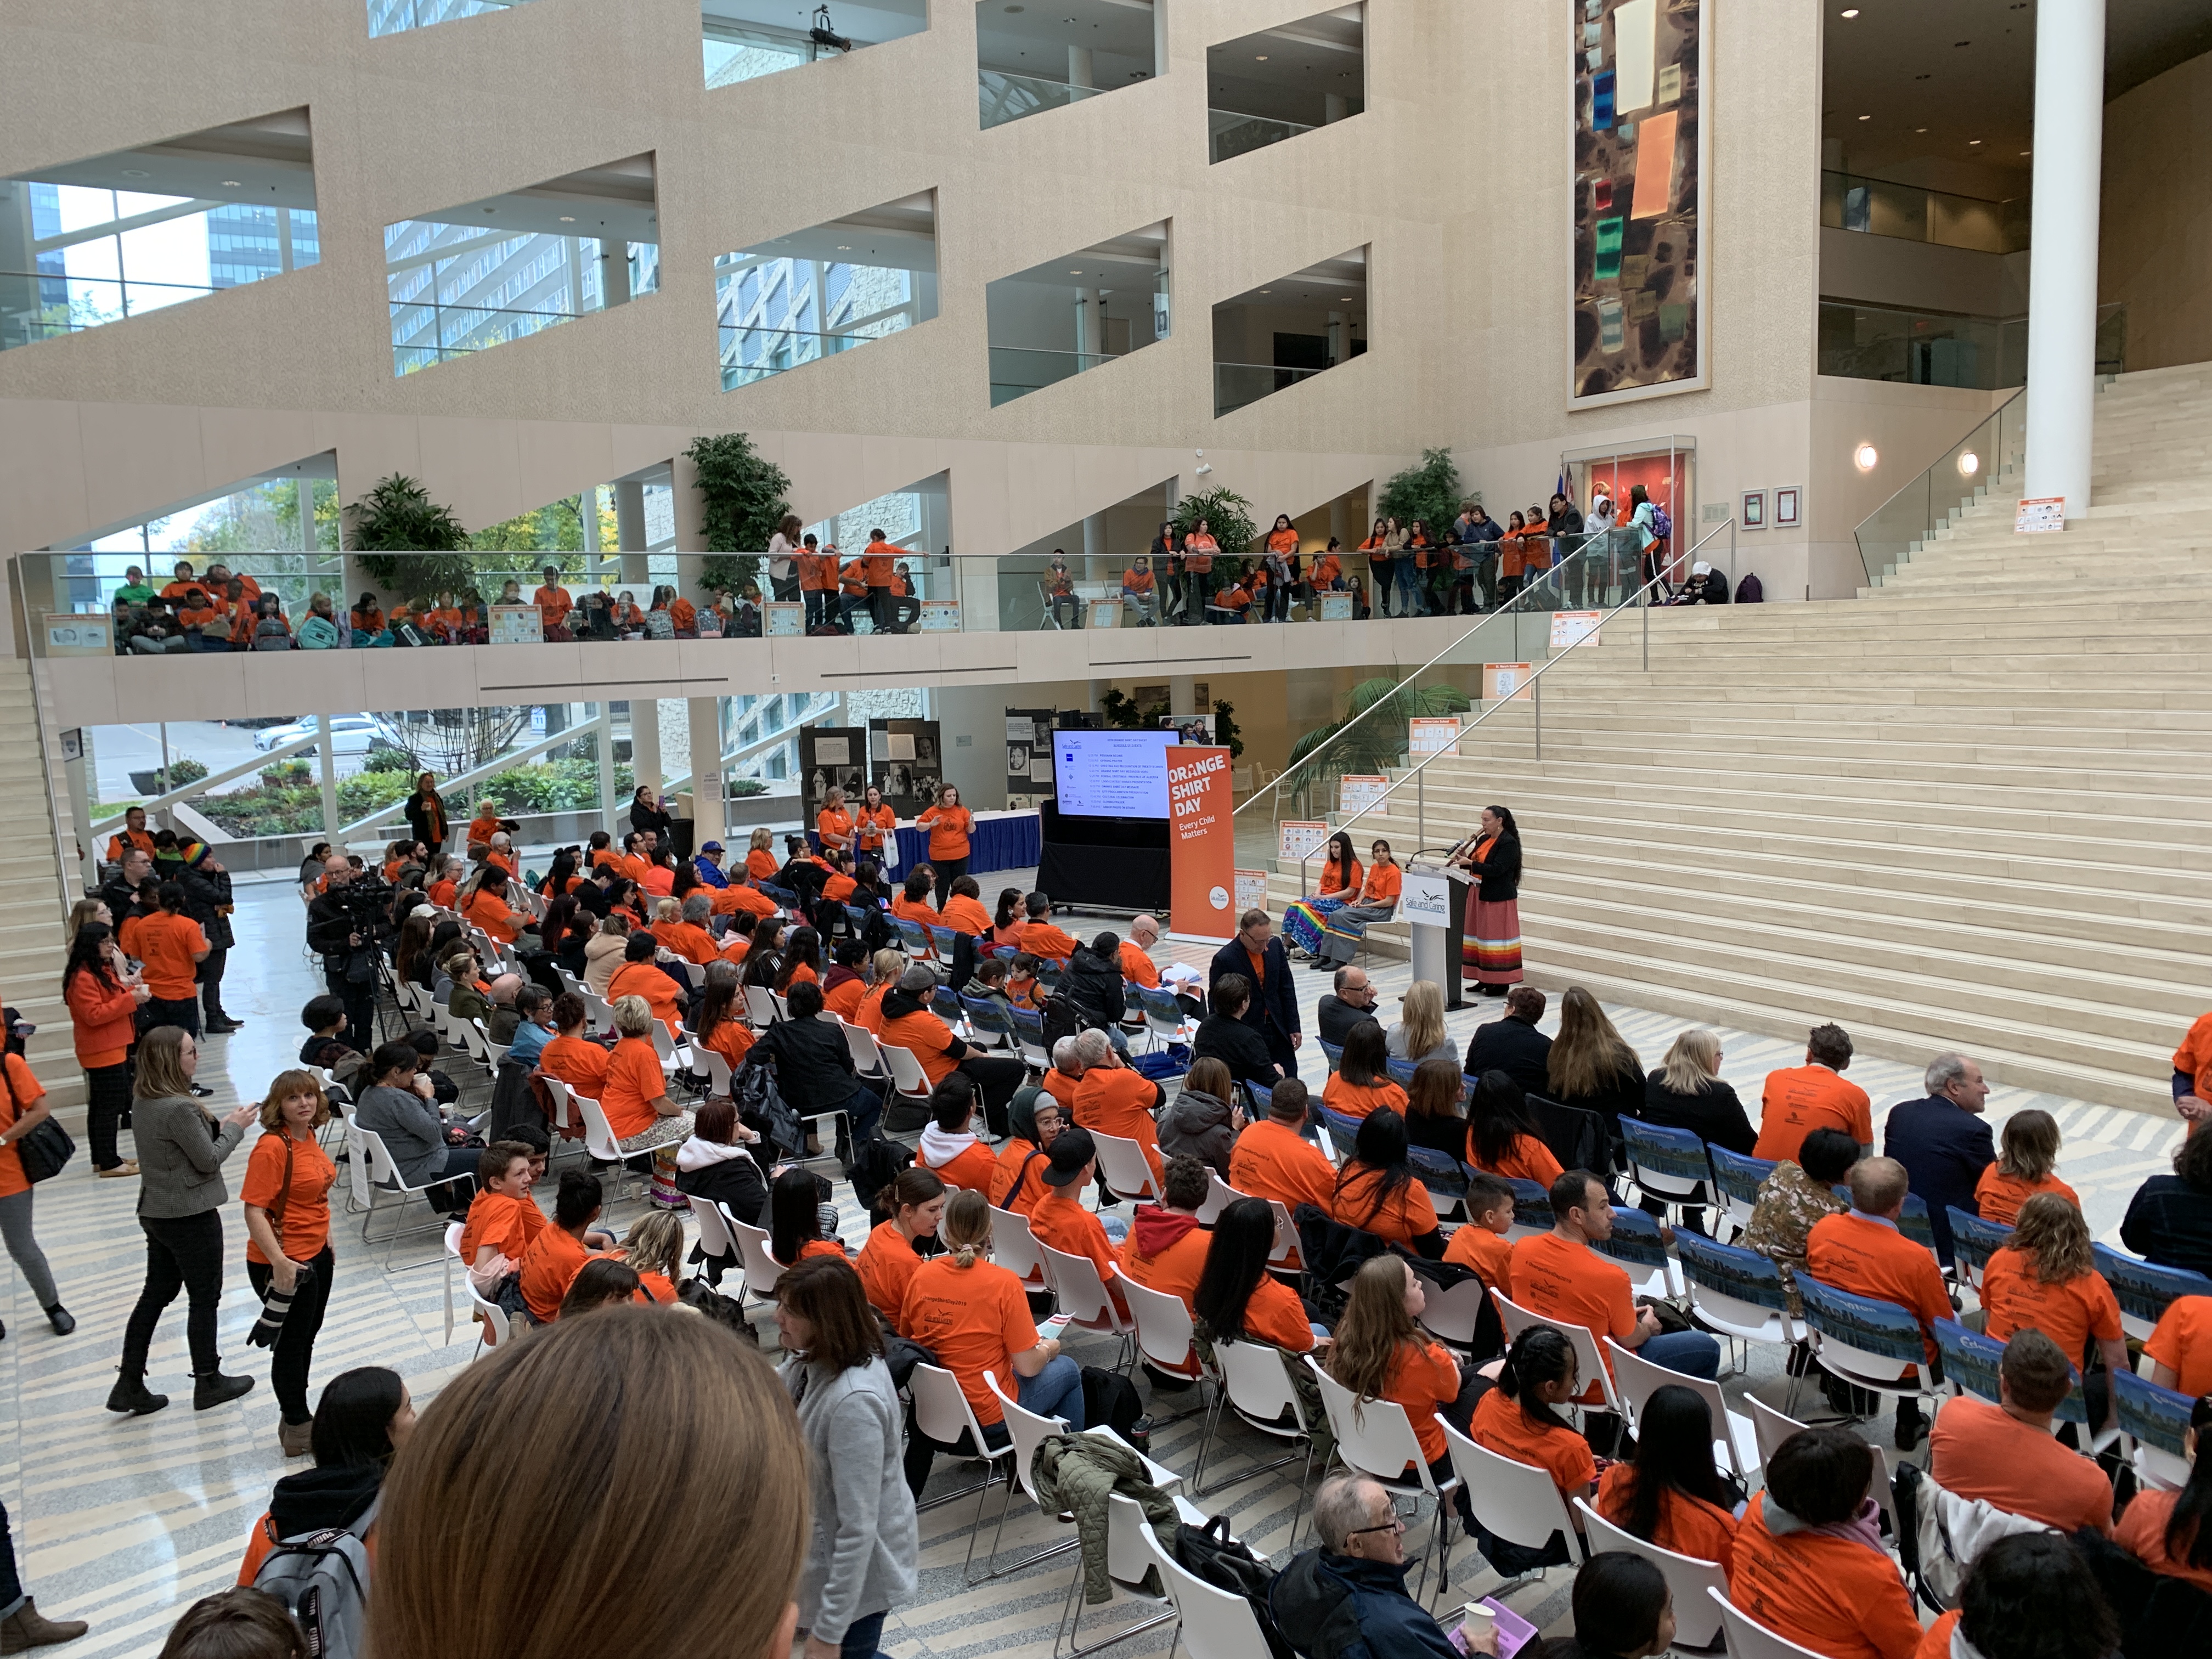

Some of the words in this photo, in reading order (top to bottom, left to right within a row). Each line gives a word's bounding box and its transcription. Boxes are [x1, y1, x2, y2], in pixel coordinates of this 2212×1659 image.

[1169, 754, 1226, 783] ORANGE
[1171, 776, 1211, 800] SHIRT
[1175, 797, 1201, 817] DAY
[1179, 821, 1198, 831] Every
[1199, 815, 1216, 826] Child
[1181, 828, 1207, 840] Matters
[1406, 898, 1417, 907] Safe
[1418, 901, 1428, 909] and
[1429, 901, 1446, 914] Caring
[1407, 1152, 1430, 1161] onton
[920, 1295, 967, 1306] #OrangeShirtDay2019
[307, 1532, 335, 1549] PUMA
[309, 1627, 319, 1657] PUMA
